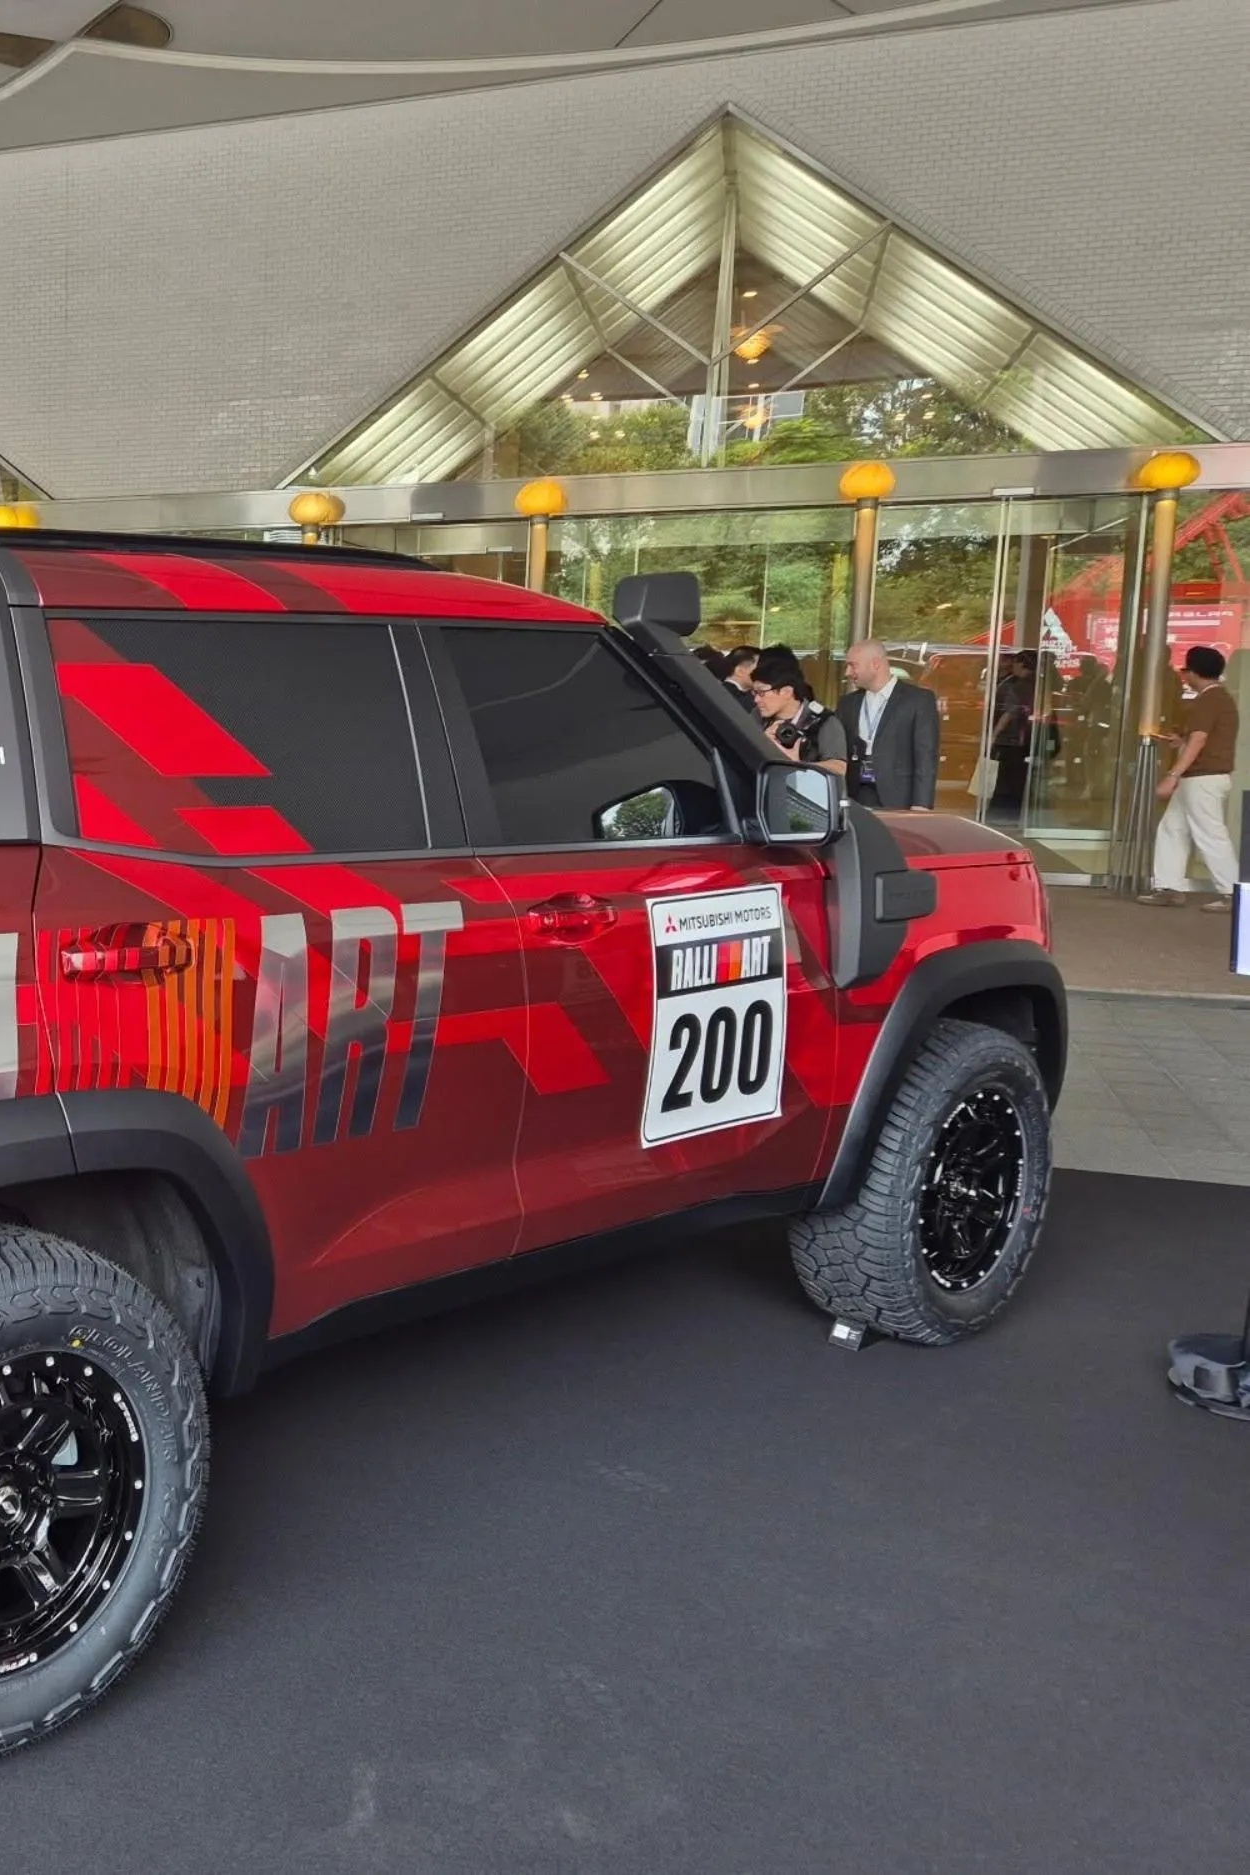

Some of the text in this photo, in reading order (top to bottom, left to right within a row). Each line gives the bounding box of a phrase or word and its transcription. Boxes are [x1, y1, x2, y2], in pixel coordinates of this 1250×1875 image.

[678, 906, 771, 931] MITSUBISHI MOTORS
[661, 1000, 773, 1113] 200
